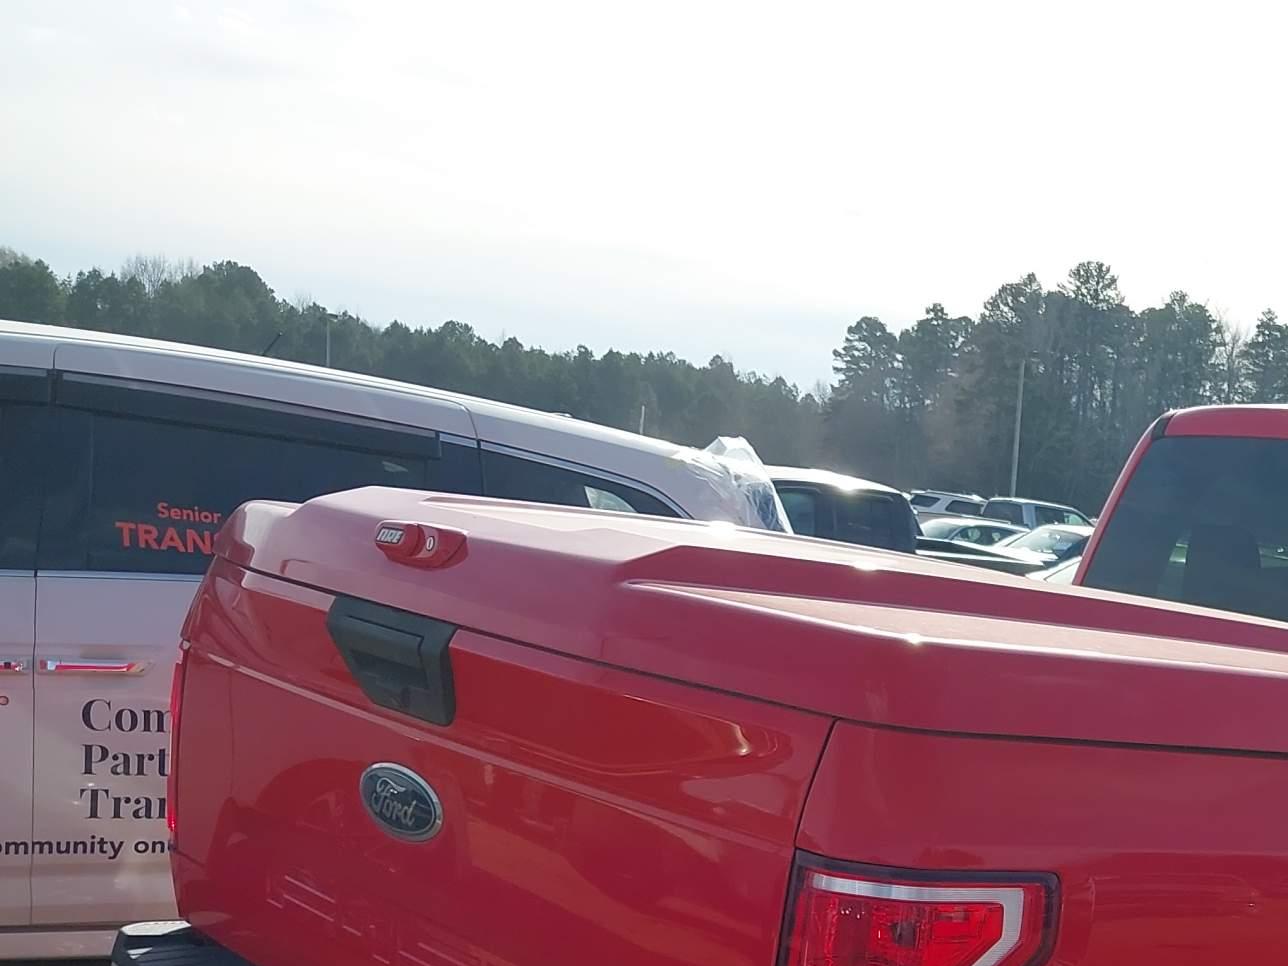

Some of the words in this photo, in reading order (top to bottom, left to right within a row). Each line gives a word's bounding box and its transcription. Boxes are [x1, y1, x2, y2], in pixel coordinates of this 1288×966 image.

[155, 501, 221, 524] Senior
[114, 520, 216, 554] TRAN
[80, 743, 171, 777] Part
[0, 835, 124, 860] mmunity
